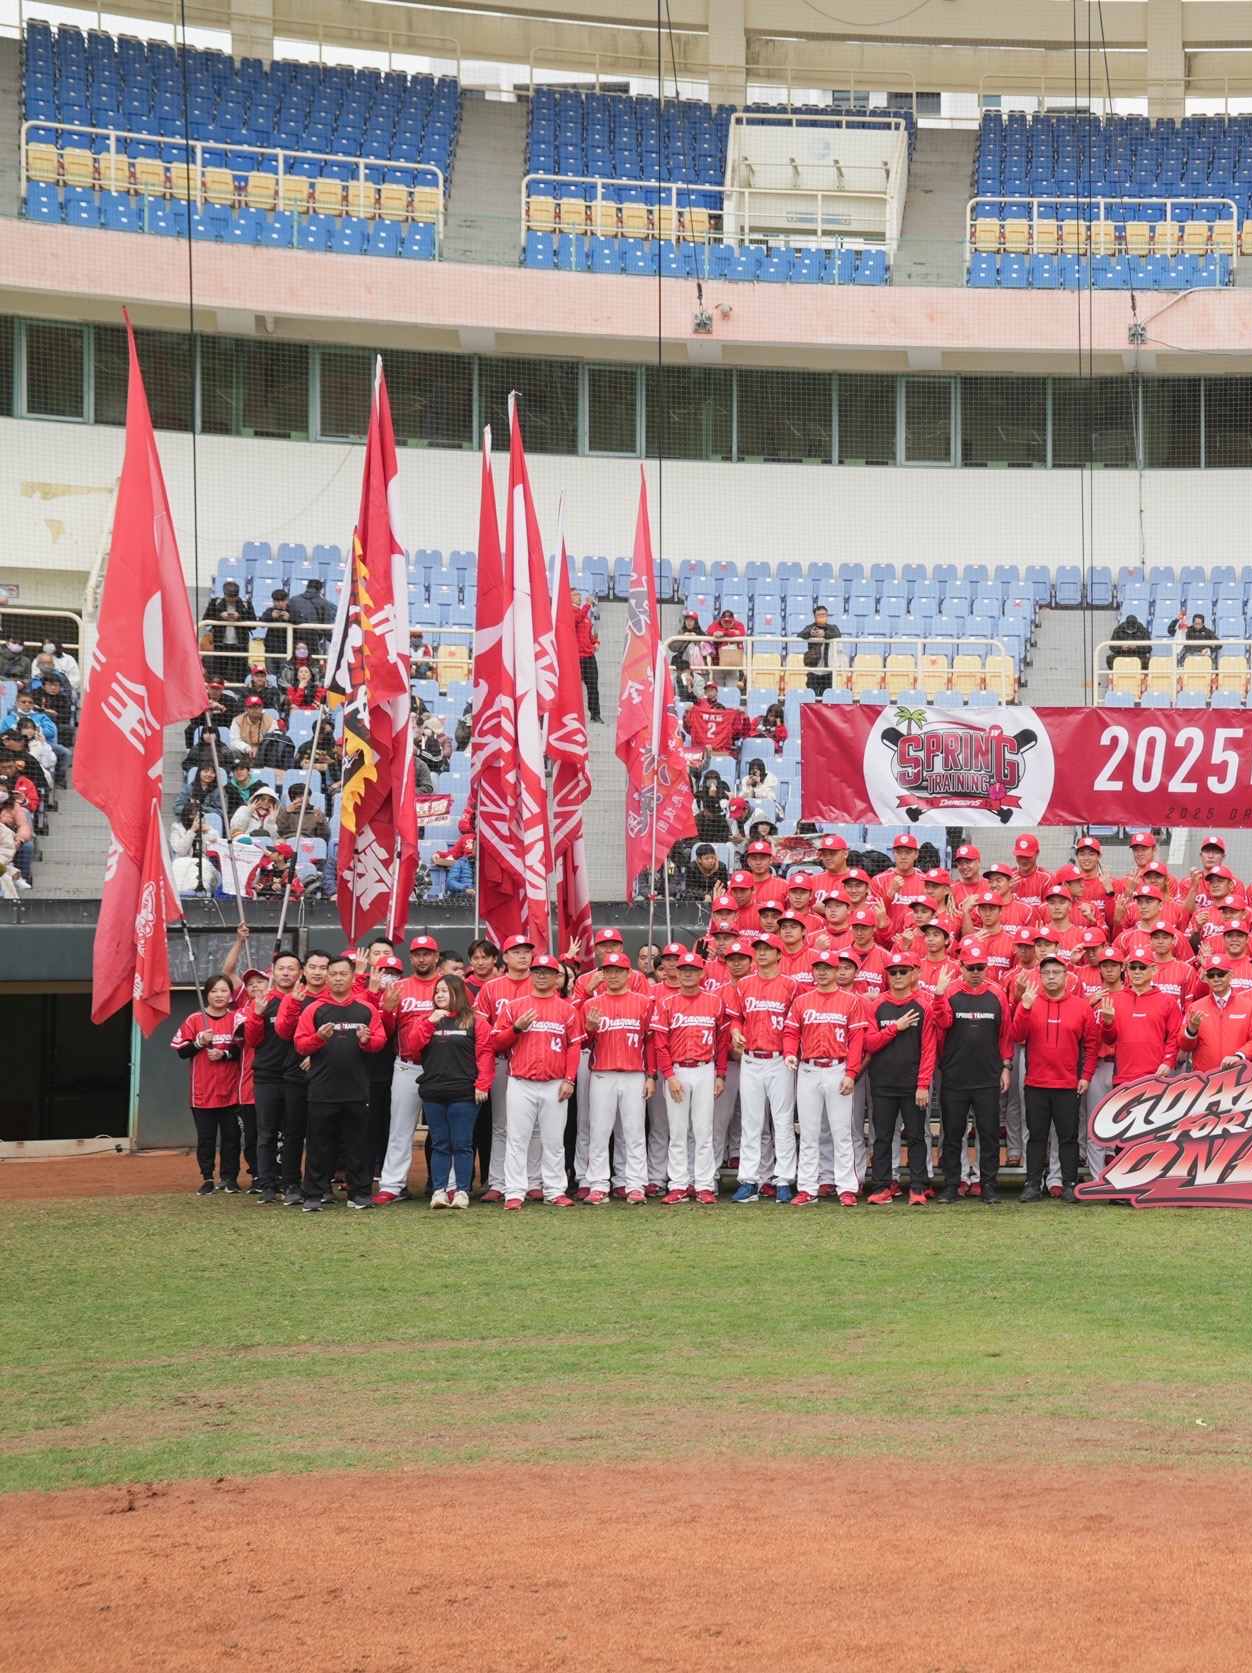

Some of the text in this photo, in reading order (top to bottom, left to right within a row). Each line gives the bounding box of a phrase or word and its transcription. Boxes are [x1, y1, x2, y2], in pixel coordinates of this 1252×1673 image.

[706, 722, 716, 738] 2
[897, 732, 1019, 787] SPRING
[927, 773, 990, 794] TRAINING
[1166, 807, 1216, 820] 2025
[745, 997, 786, 1013] Dragons
[597, 1016, 640, 1033] Dragons
[669, 1013, 716, 1029] Dragons
[770, 1015, 784, 1030] 93
[803, 1009, 848, 1025] Dragons
[701, 1030, 713, 1045] 76
[1165, 1111, 1248, 1143] FOR
